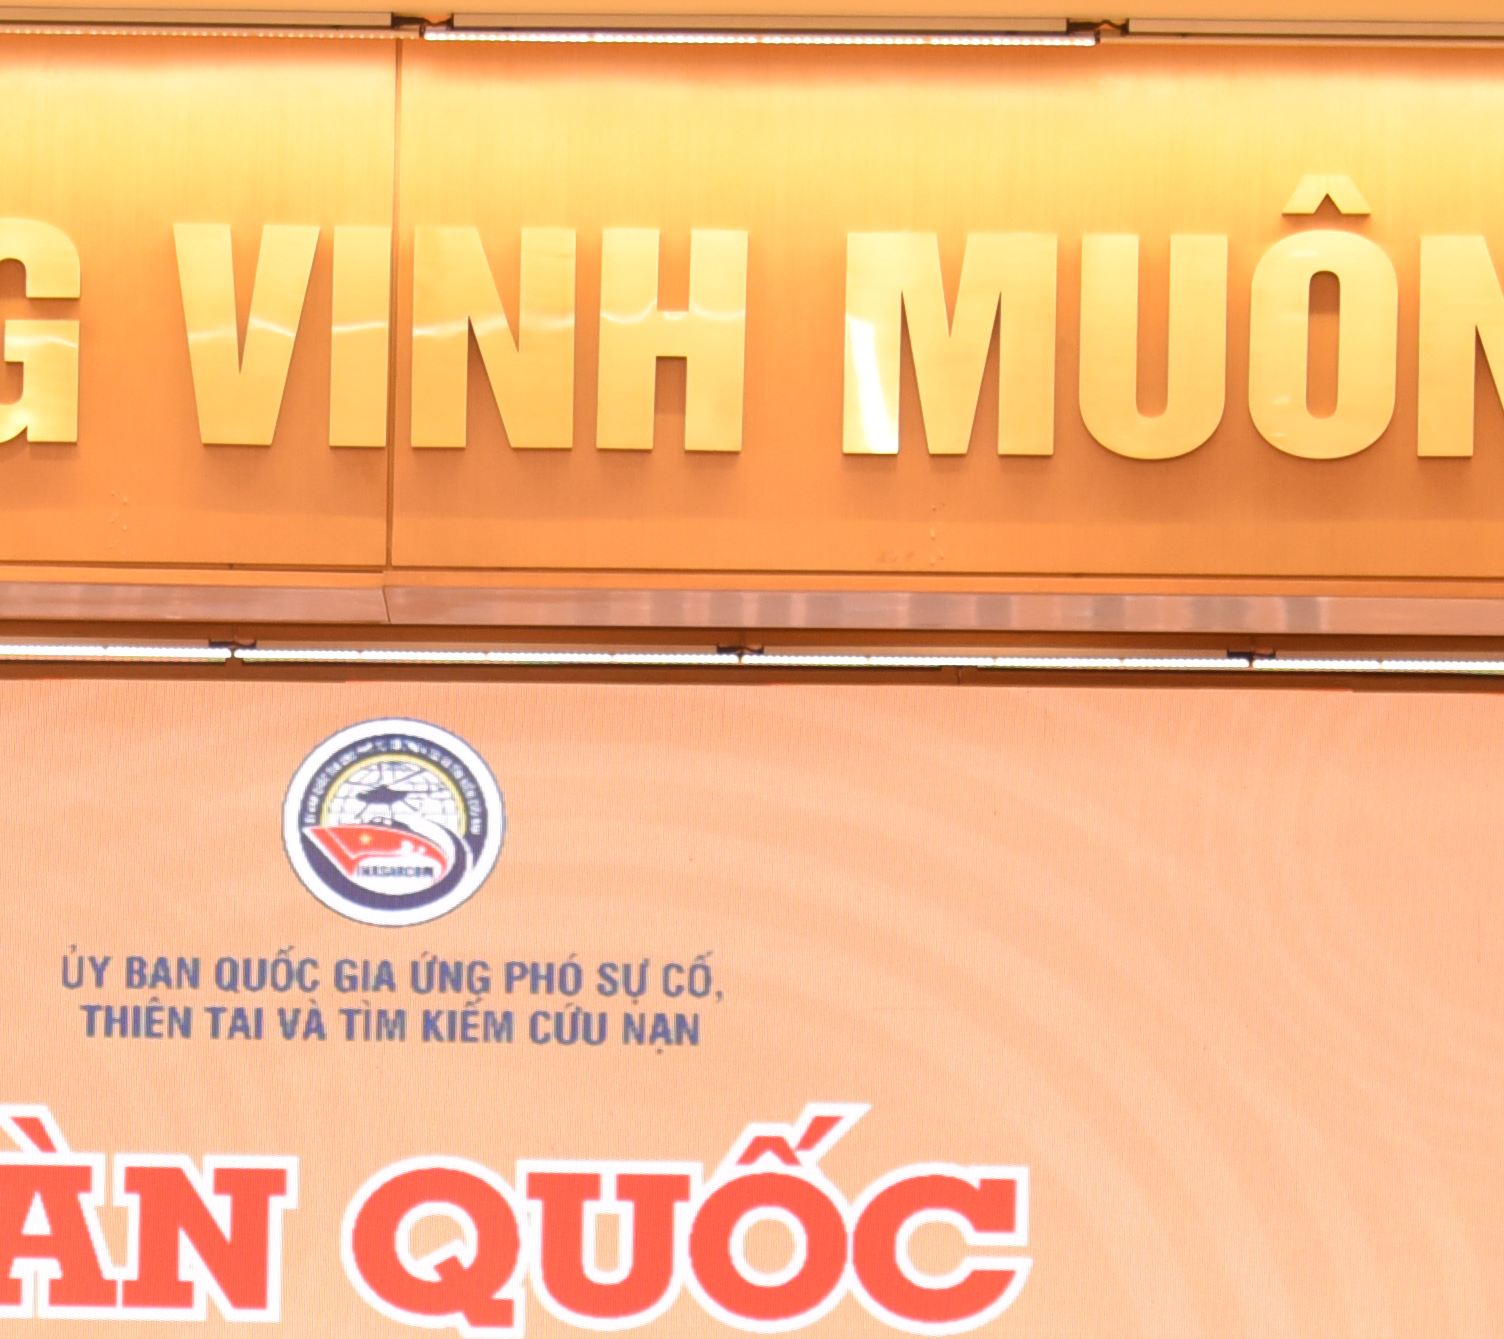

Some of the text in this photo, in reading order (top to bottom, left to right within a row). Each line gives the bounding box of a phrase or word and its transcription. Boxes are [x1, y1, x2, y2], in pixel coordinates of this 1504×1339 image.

[173, 222, 749, 454] VINH
[61, 946, 723, 1003] ỦY BAN QUỐC GIA ỨNG PHÓ SỰ CỐ,
[82, 996, 699, 1055] THIÊN TAI VÀ TÌM KIẾM CỨU NẠN
[352, 1115, 1016, 1327] QUỐC
